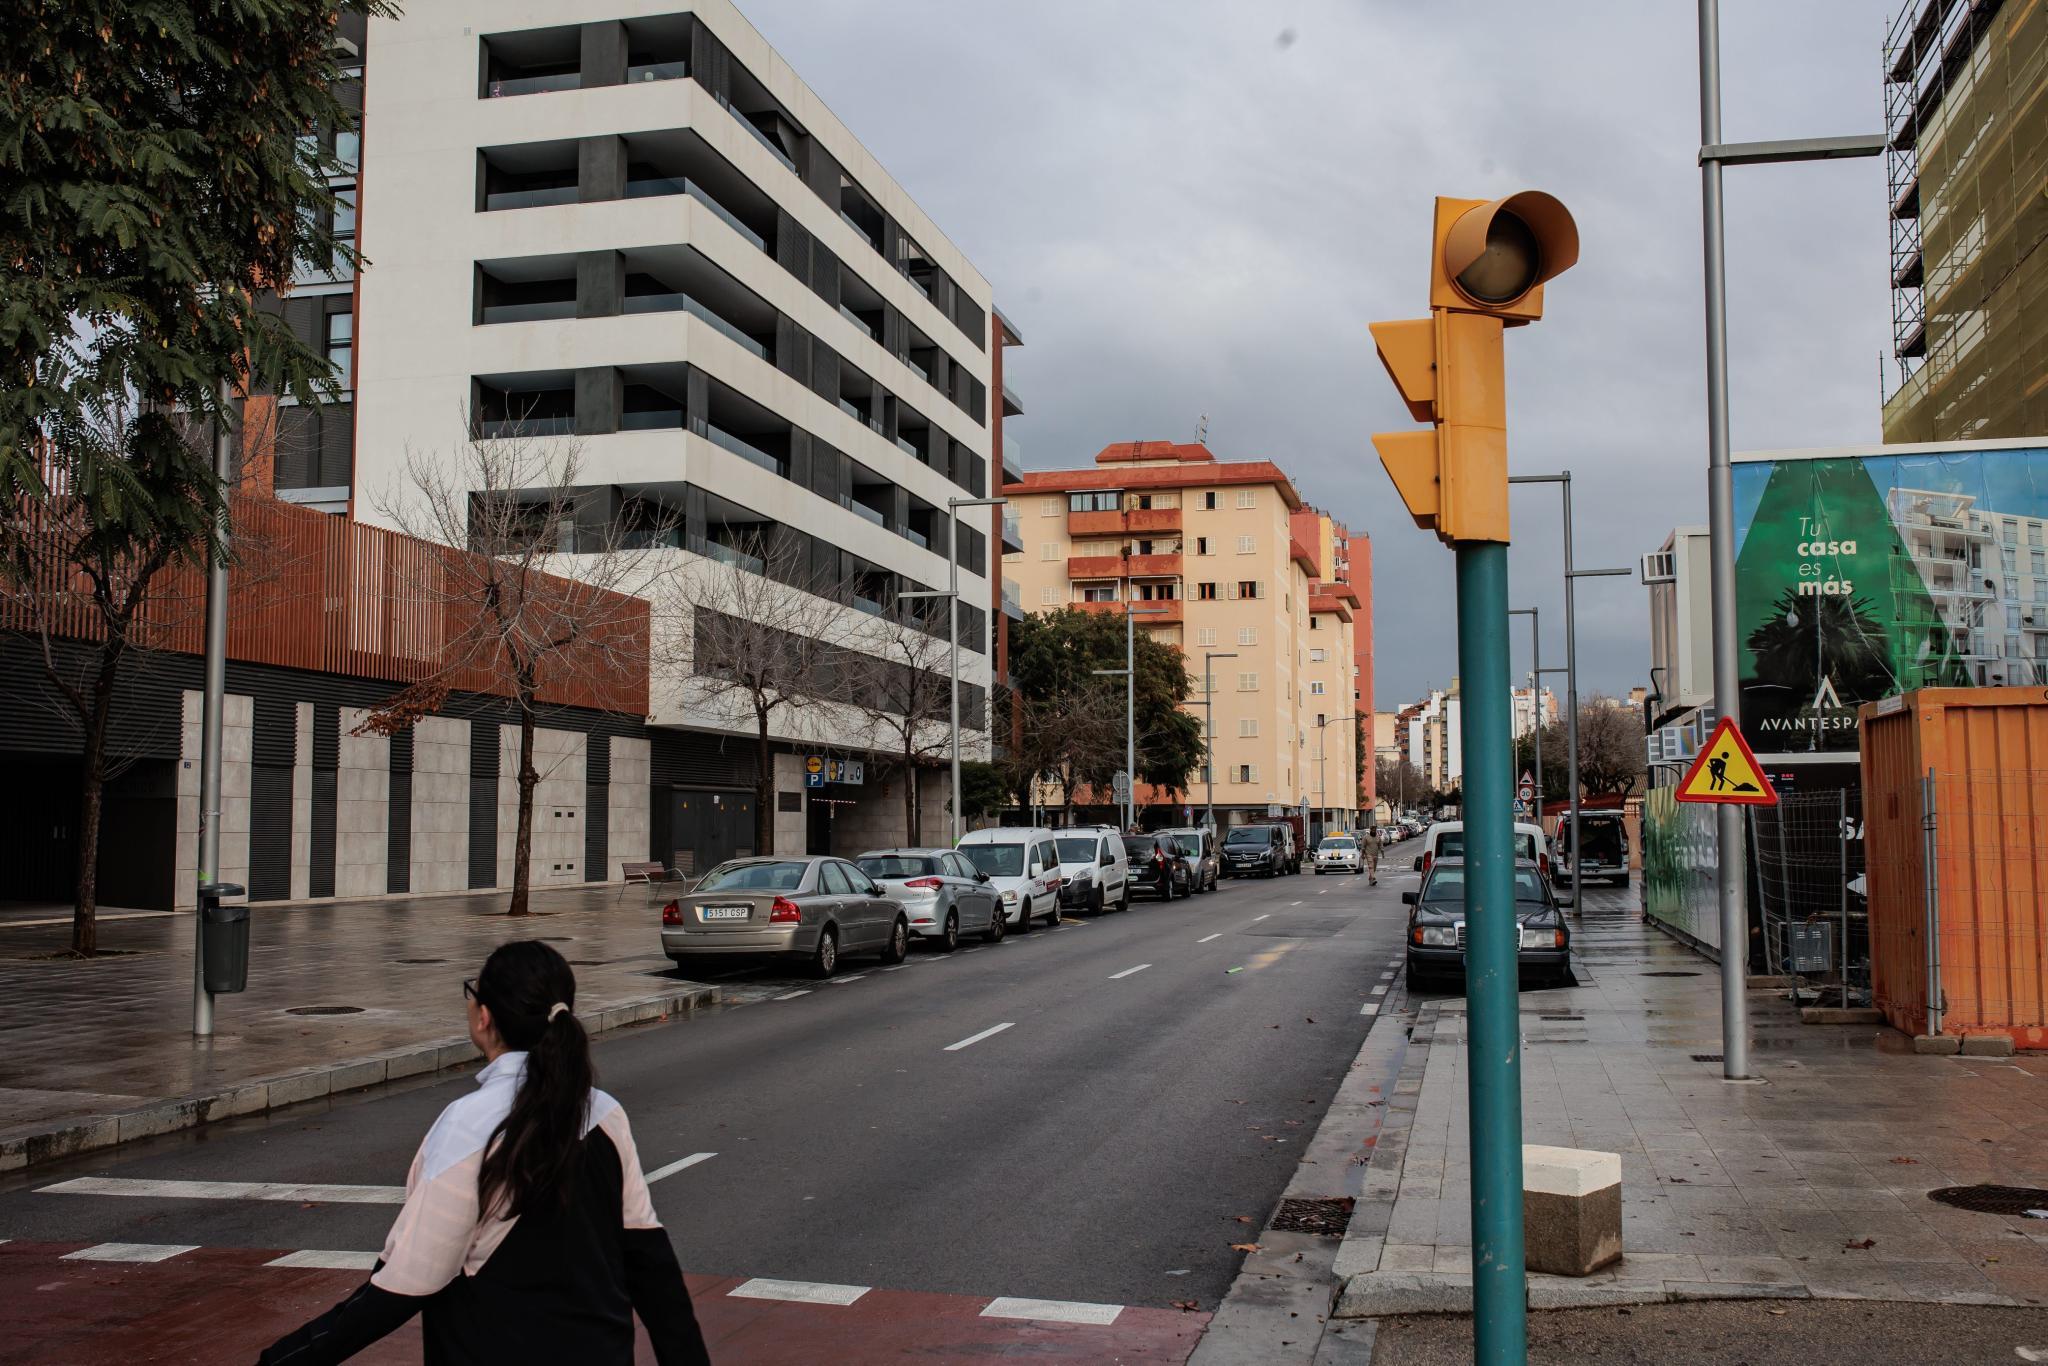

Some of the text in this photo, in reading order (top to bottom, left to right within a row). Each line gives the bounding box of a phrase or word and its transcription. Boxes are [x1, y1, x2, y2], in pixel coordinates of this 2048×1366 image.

[1799, 517, 1821, 537] Tu
[1797, 540, 1857, 557] casa
[1799, 563, 1821, 577] es
[1798, 575, 1853, 596] más
[811, 775, 819, 786] P
[709, 908, 727, 917] 5151
